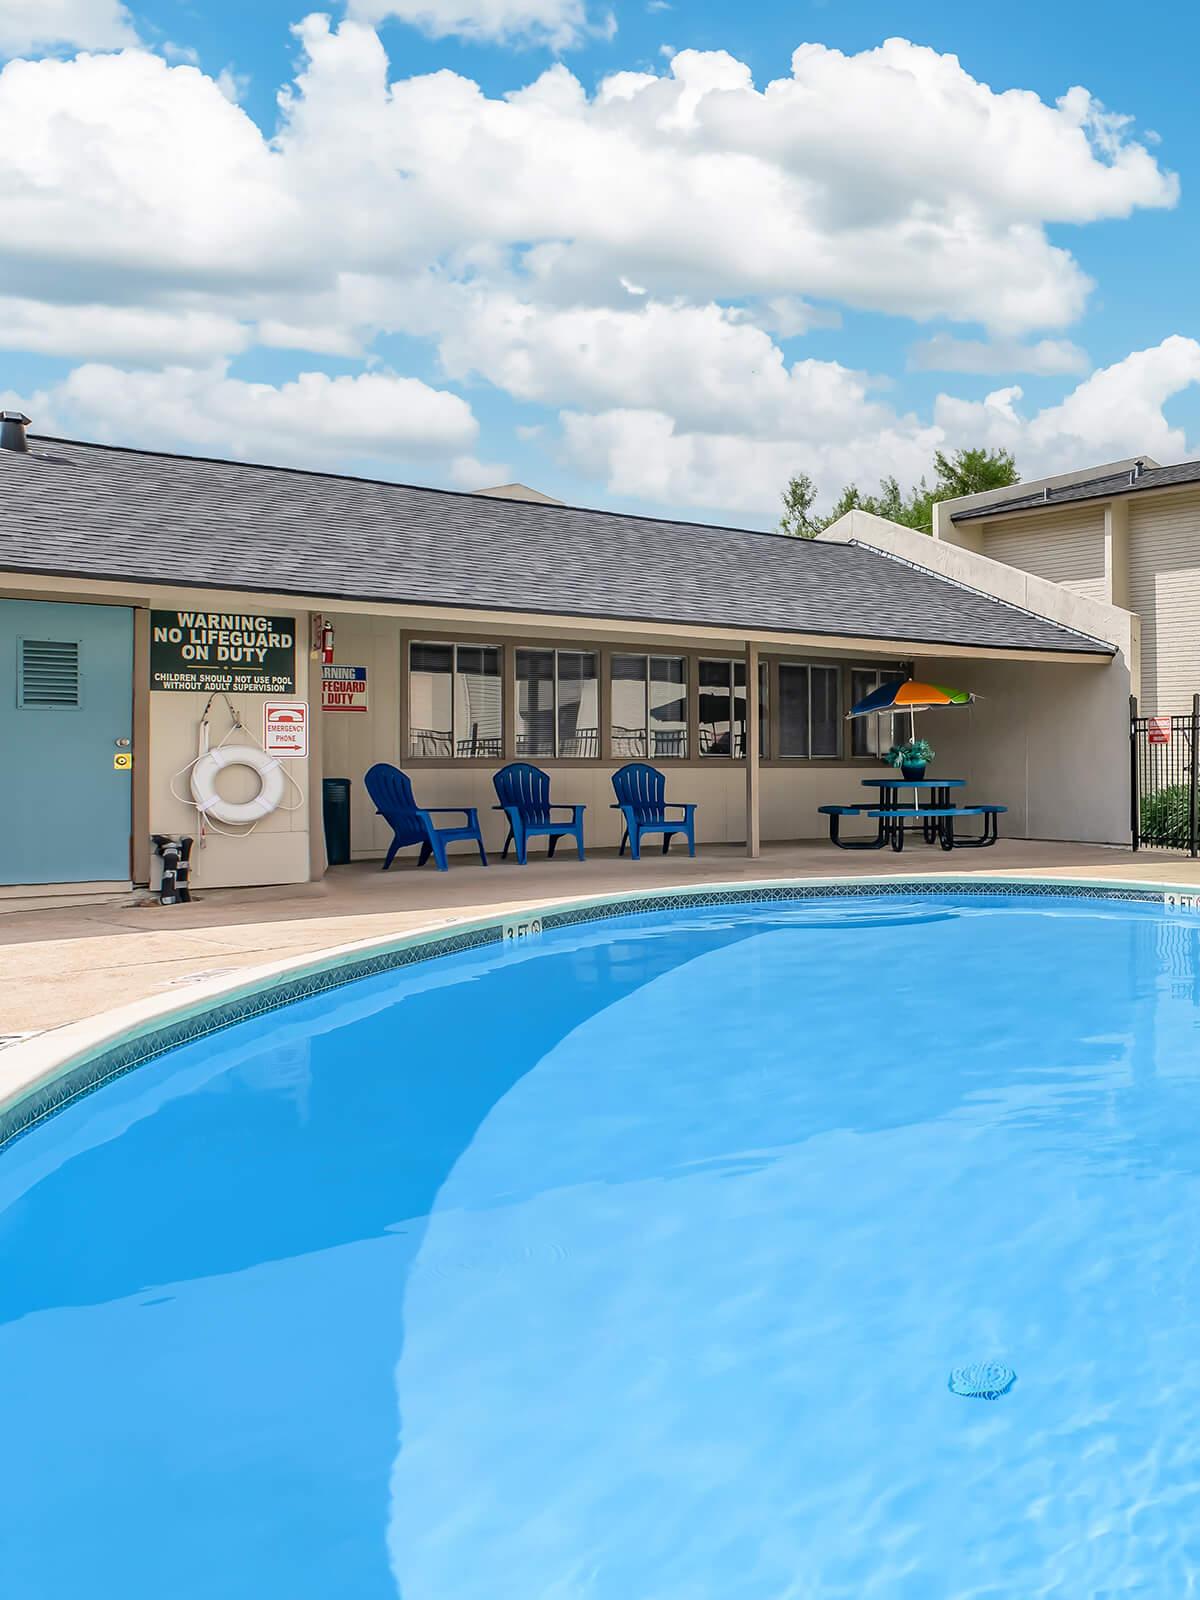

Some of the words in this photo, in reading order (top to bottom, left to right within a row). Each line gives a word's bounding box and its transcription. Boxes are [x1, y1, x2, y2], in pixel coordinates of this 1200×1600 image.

[177, 612, 272, 632] WARNING:
[153, 627, 182, 643] NO
[190, 629, 293, 648] LIFEGUARD
[181, 644, 209, 660] ON
[217, 646, 268, 662] DUTY
[154, 673, 196, 682] CHILDREN
[200, 674, 233, 683] SHOULD
[235, 675, 251, 683] NOT
[254, 676, 270, 684] USE
[272, 676, 293, 685] POOL
[162, 682, 202, 690] WITHOUT
[204, 683, 230, 691] ADULT
[232, 683, 285, 692] SUPERVISION
[328, 693, 353, 704] DUTY
[1181, 896, 1193, 908] FT
